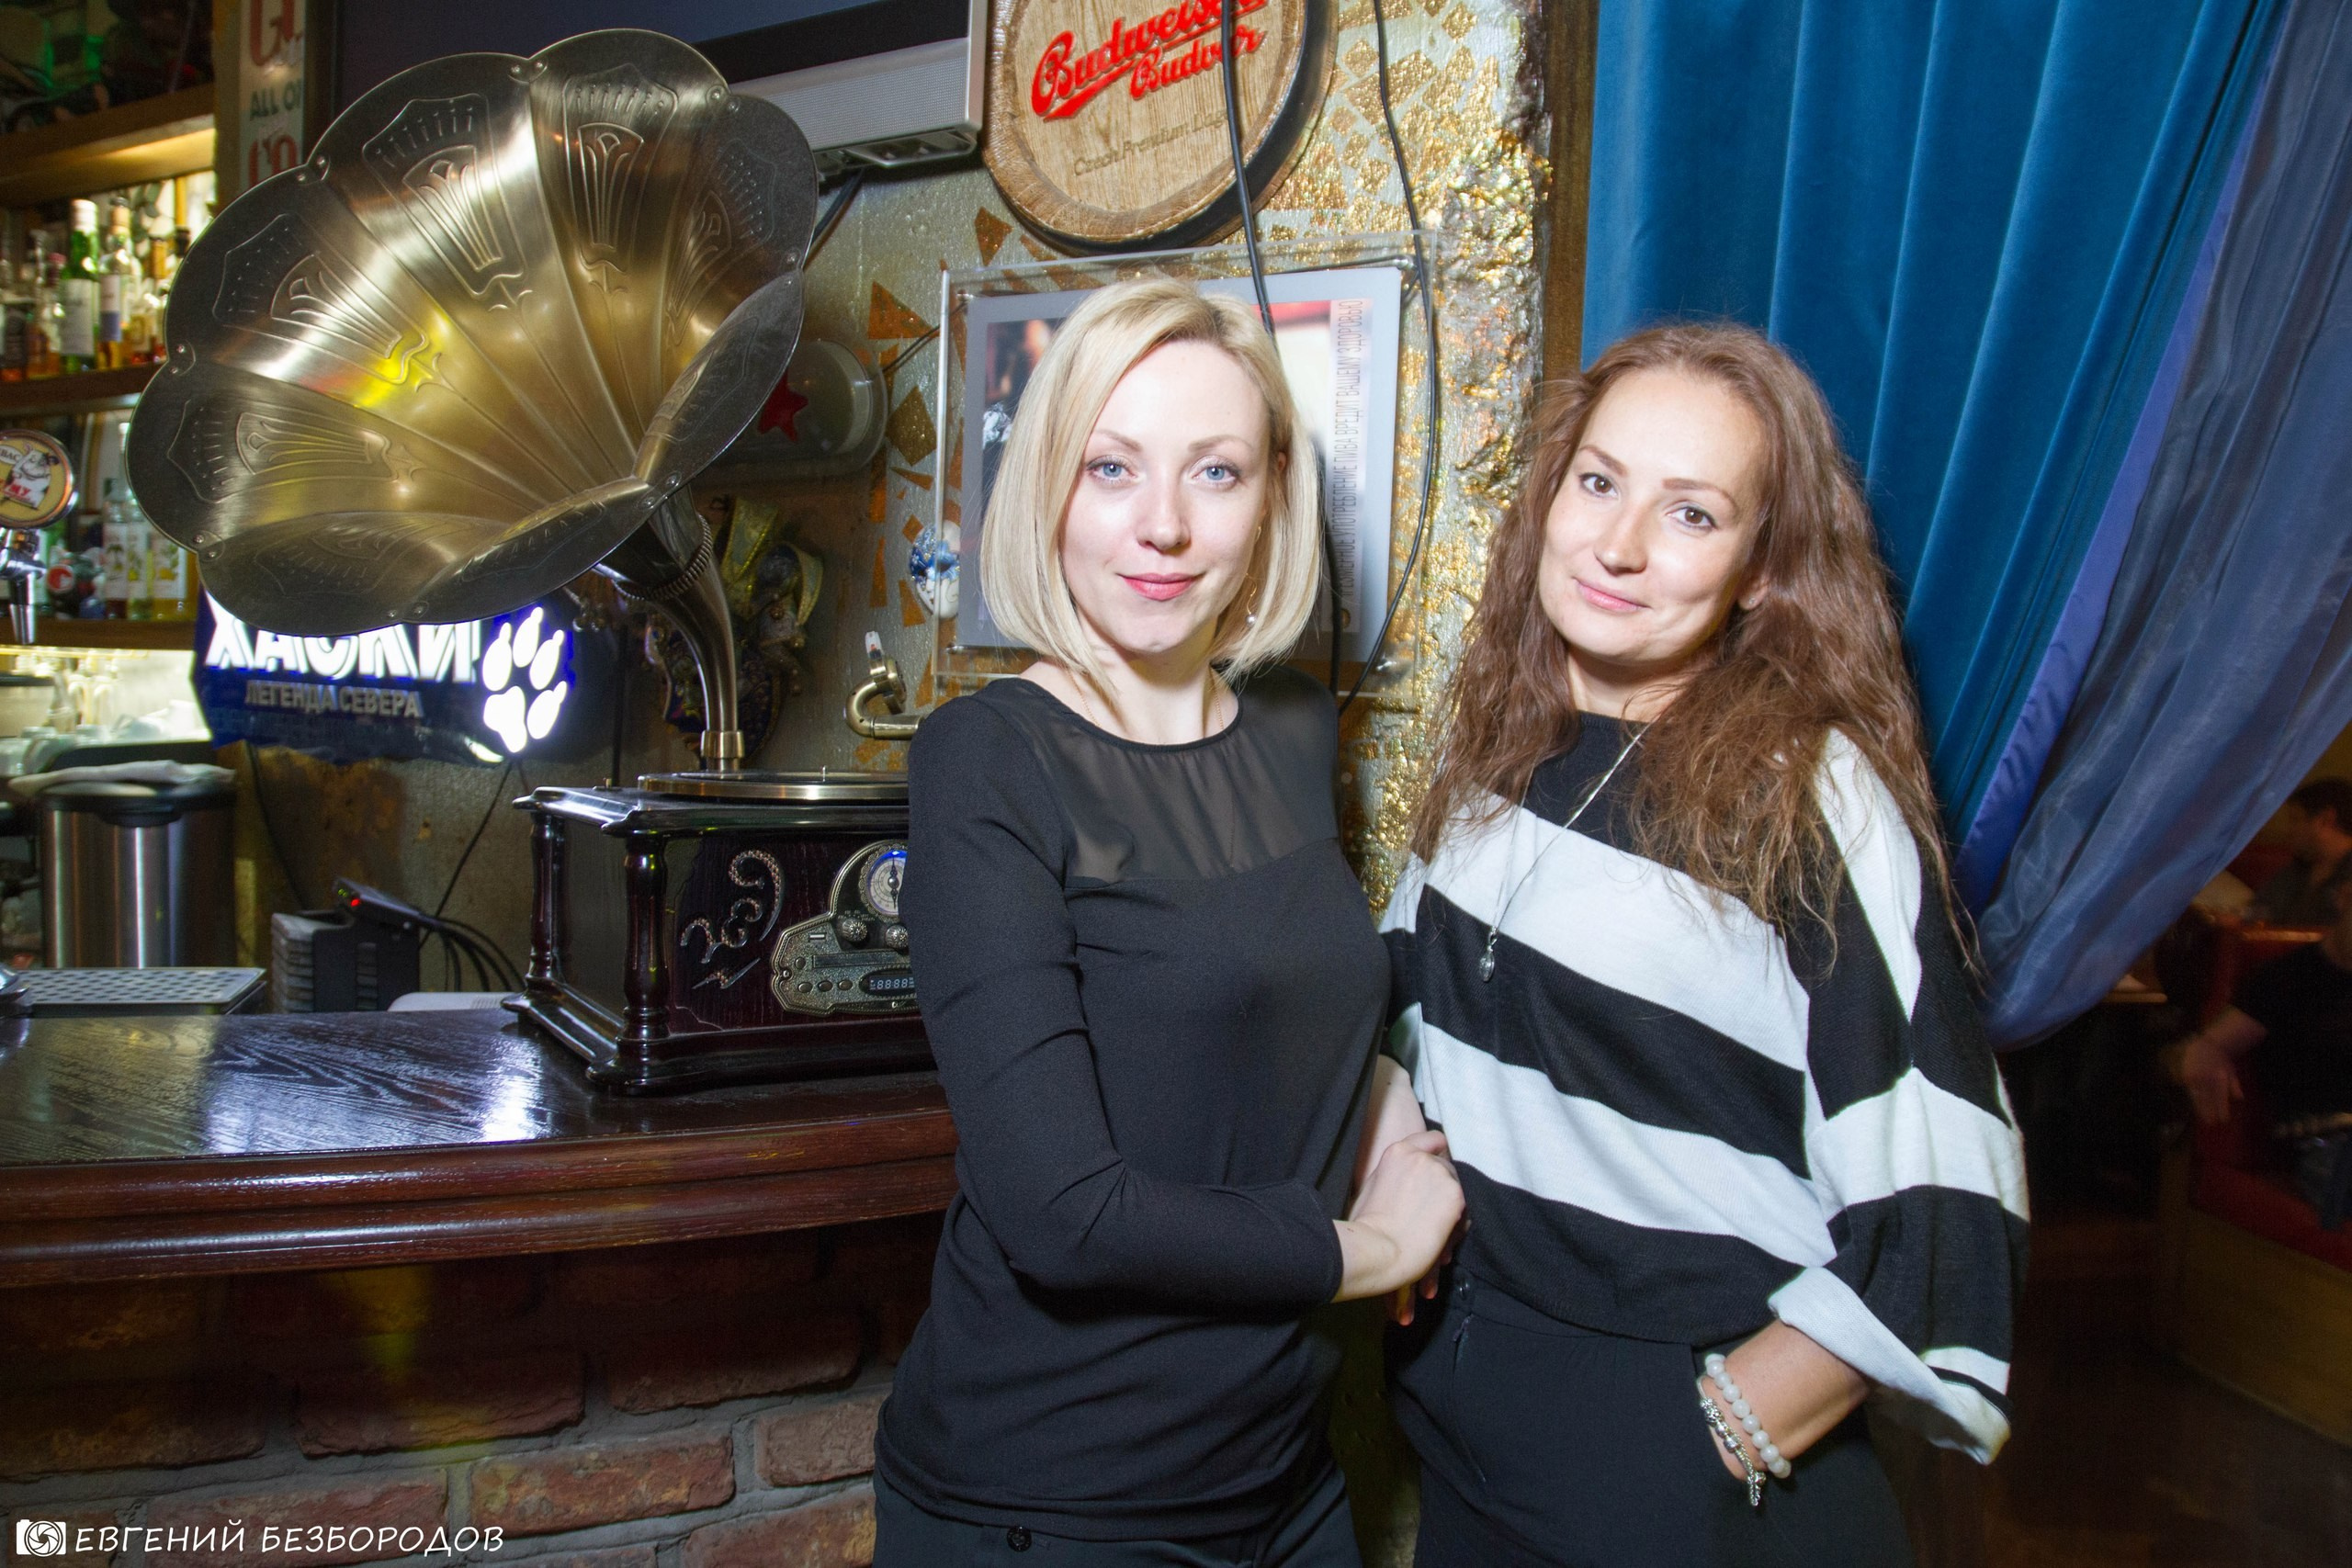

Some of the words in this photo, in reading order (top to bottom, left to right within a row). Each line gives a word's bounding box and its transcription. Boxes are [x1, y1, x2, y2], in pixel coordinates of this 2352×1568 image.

[1193, 109, 1229, 132] Lage
[1337, 299, 1366, 353] ЗДОРОВЬЮ
[1336, 355, 1362, 396] ВАШЕМУ
[1335, 400, 1363, 434] ВРЕДИТ
[1333, 438, 1359, 462] ПИВА
[1329, 465, 1358, 536] УПОТРЕБЛЕНИЕ
[245, 679, 336, 714] ЛЕГЕНДА
[338, 686, 422, 717] СЕВЕРА
